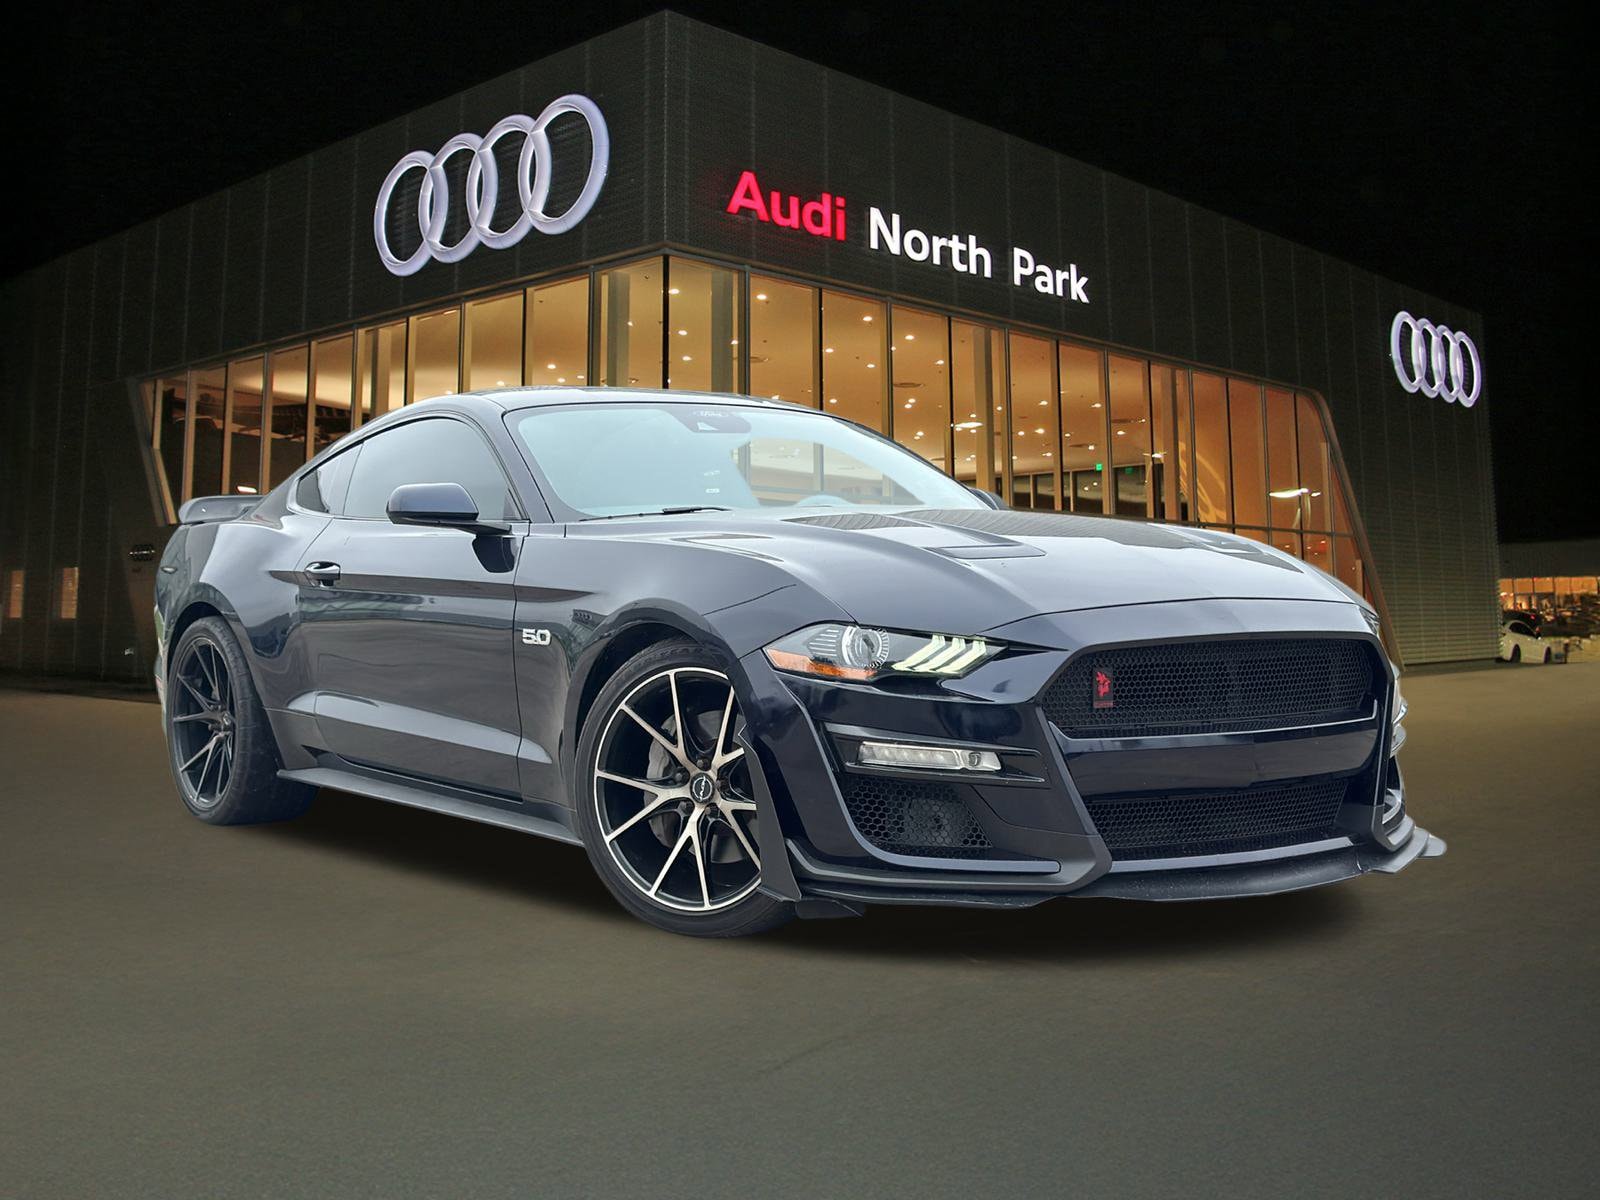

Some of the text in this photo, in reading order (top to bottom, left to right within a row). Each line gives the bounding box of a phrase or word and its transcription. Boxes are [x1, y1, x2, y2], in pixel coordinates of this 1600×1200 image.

[727, 171, 1090, 303] Audi North Park
